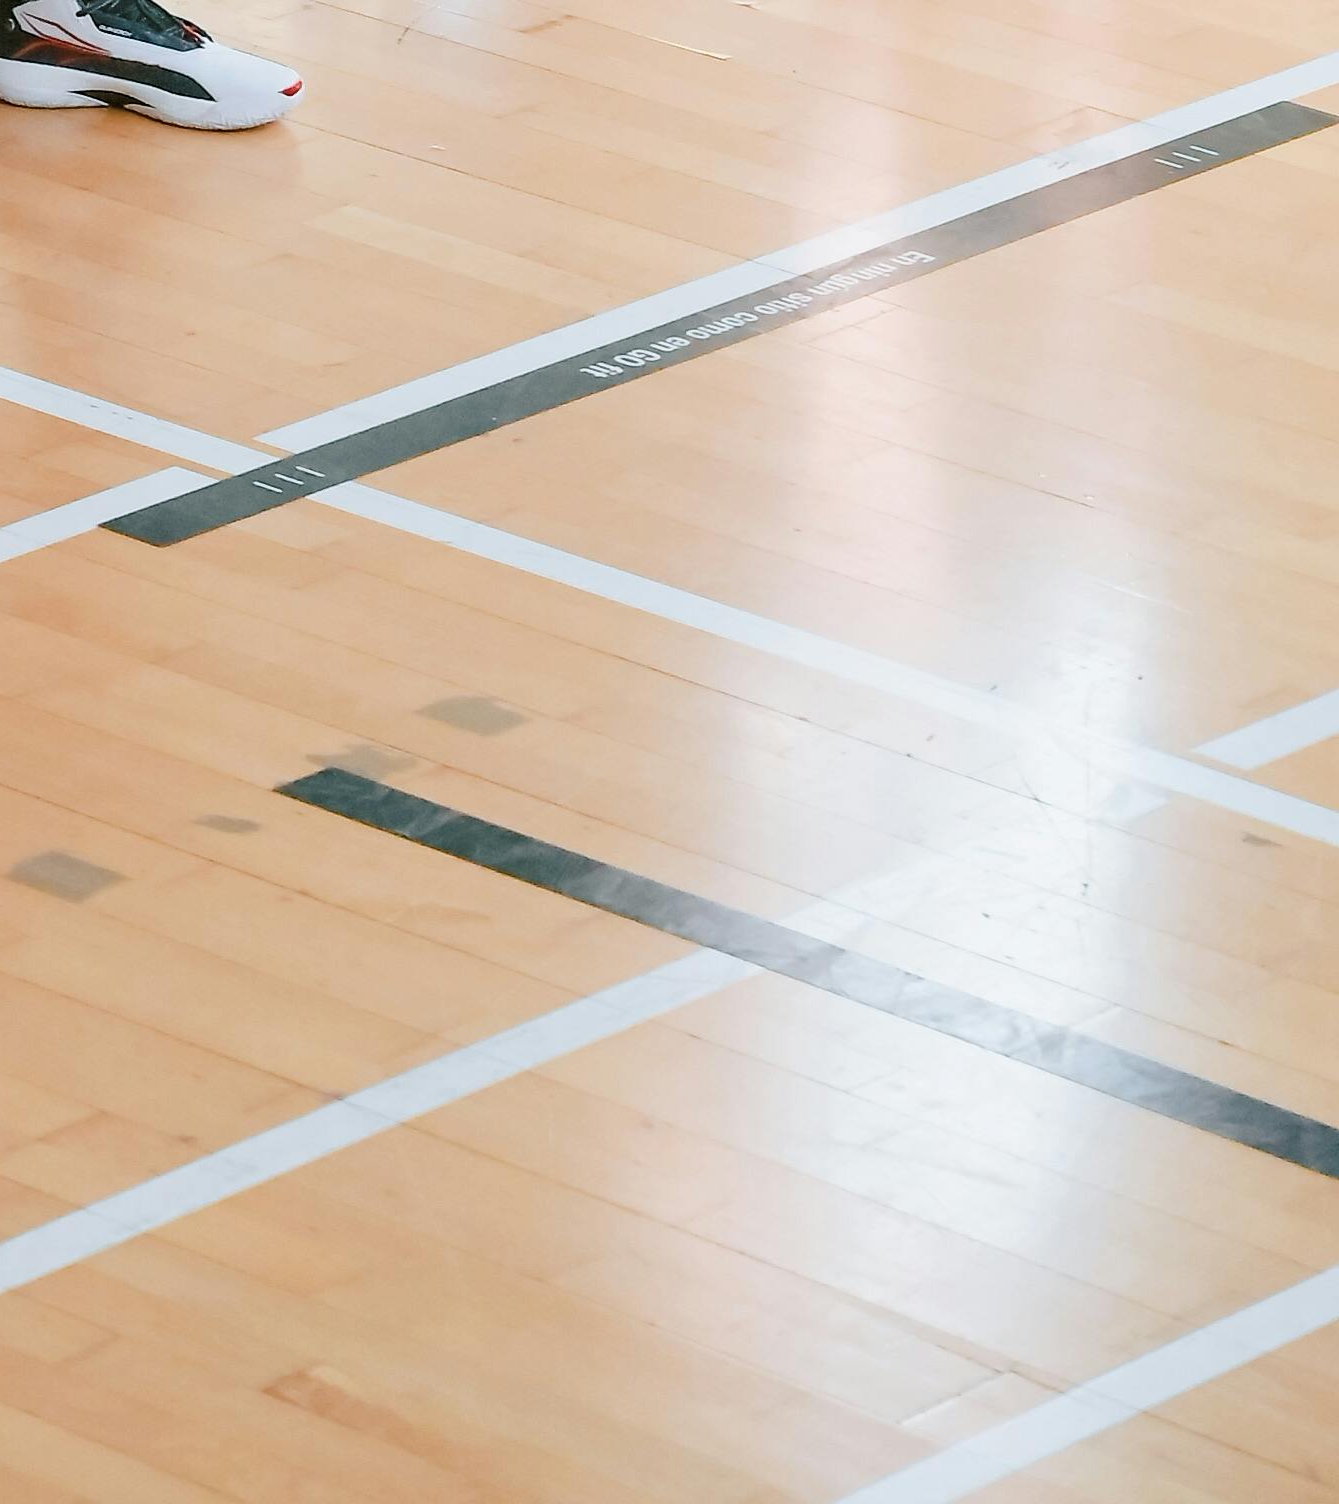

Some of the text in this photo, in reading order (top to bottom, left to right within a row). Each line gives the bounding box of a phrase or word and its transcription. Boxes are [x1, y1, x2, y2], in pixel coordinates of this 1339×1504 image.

[890, 250, 935, 266] En
[753, 292, 813, 314] sitio
[685, 312, 759, 340] como
[649, 336, 691, 352] en
[613, 349, 661, 367] GO
[579, 362, 624, 378] fit
